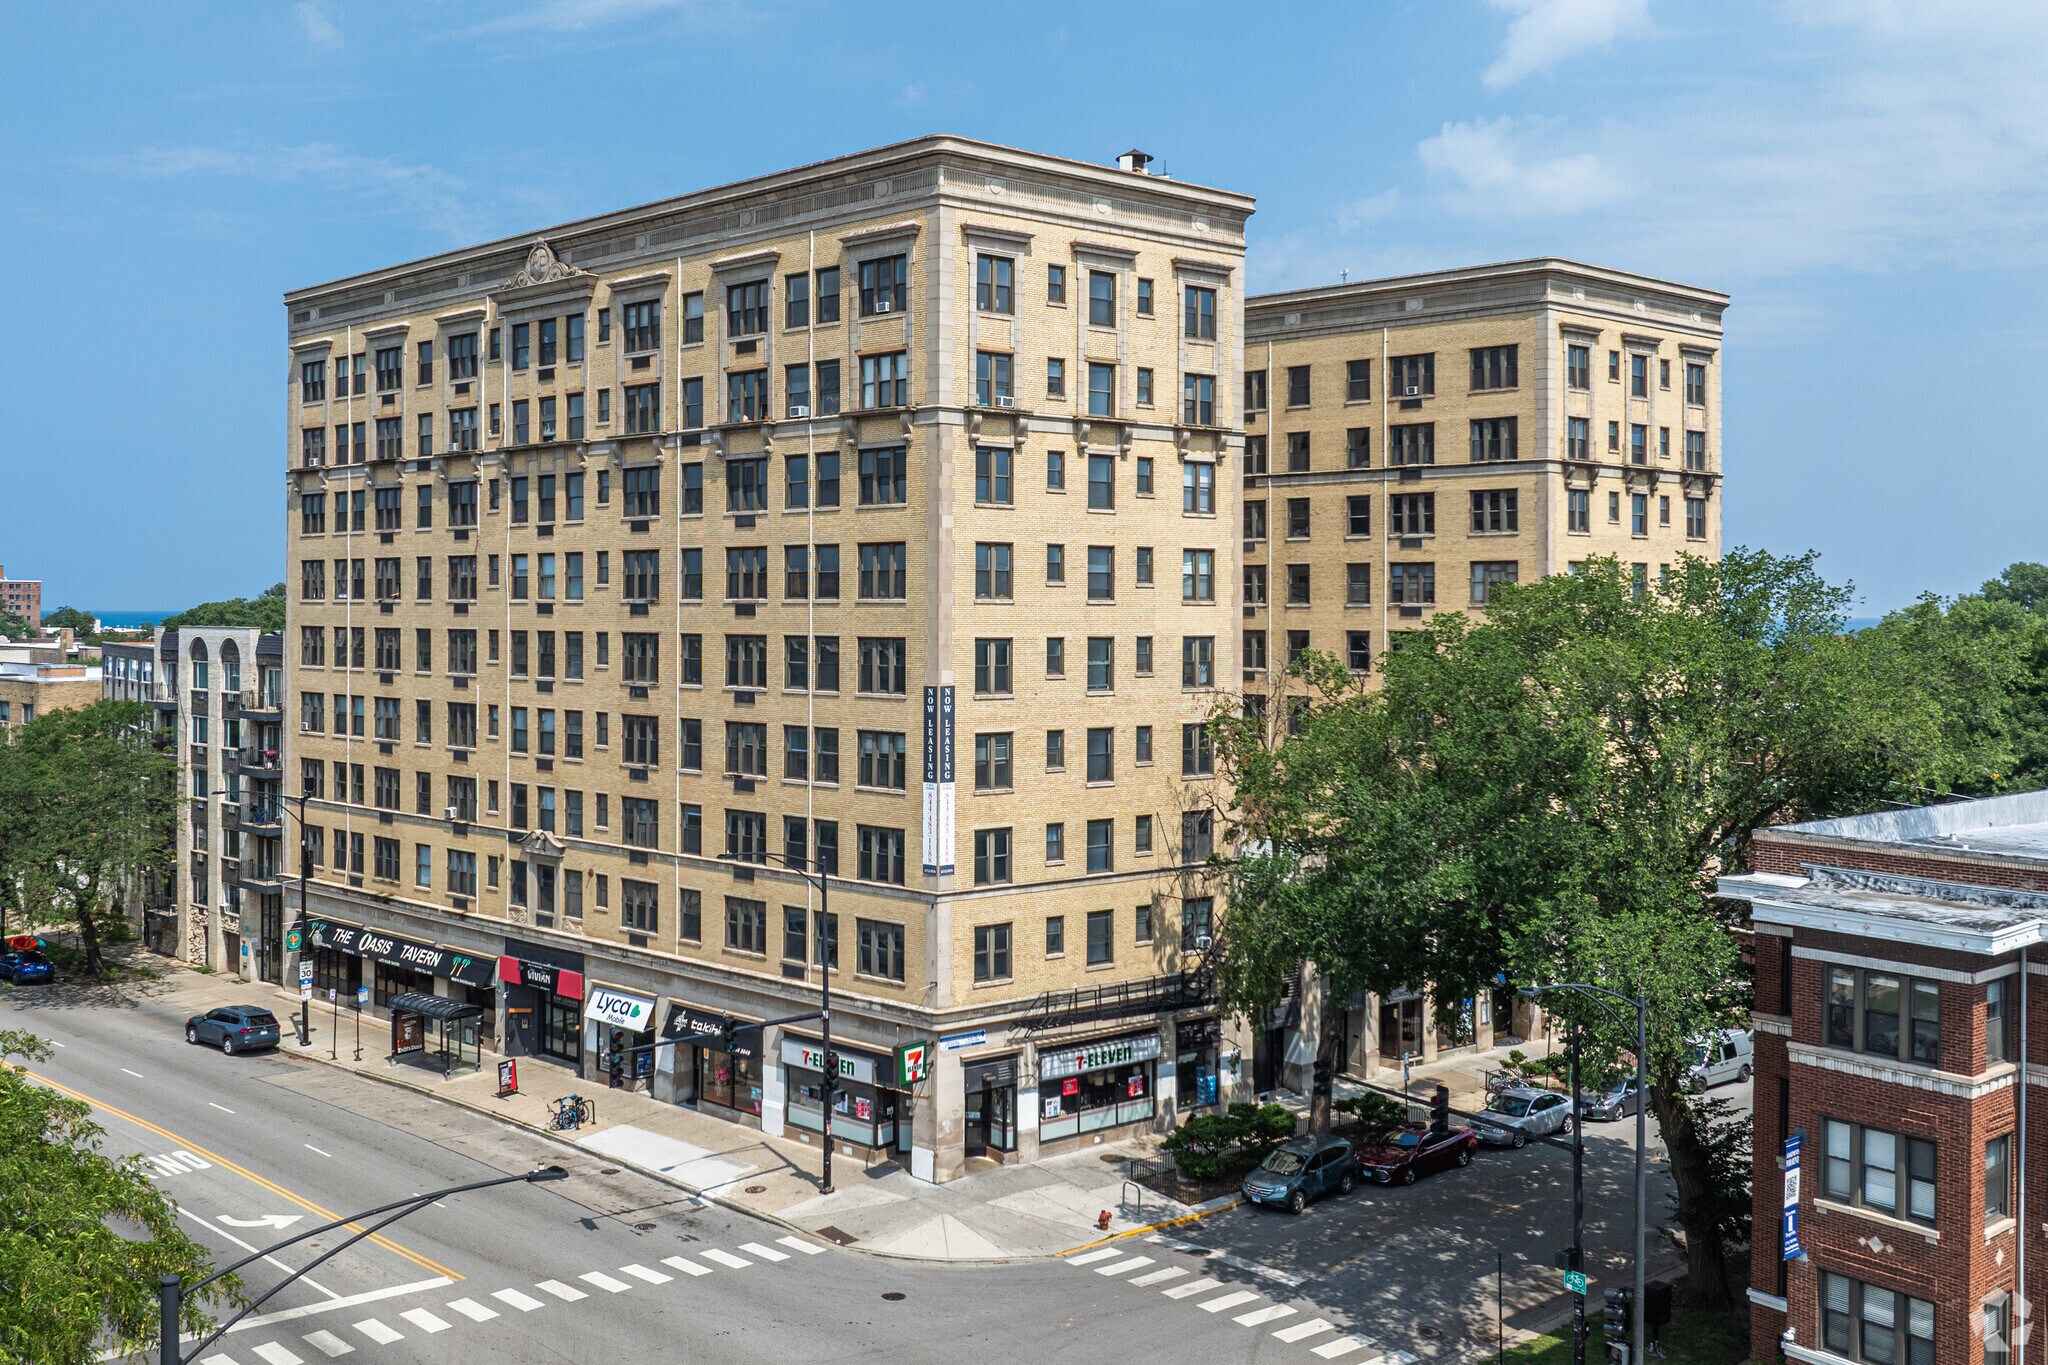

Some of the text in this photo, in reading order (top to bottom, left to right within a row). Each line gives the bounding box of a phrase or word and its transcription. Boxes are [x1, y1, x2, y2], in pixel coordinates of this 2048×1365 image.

[927, 688, 935, 713] NOW
[944, 688, 952, 713] NOW
[333, 928, 443, 967] THE OASIS TAVERN
[301, 970, 312, 978] 30
[527, 970, 551, 984] VIVIAN
[596, 992, 632, 1016] Lyca
[606, 1014, 625, 1025] Mobile
[802, 1049, 855, 1076] 7-ELEn
